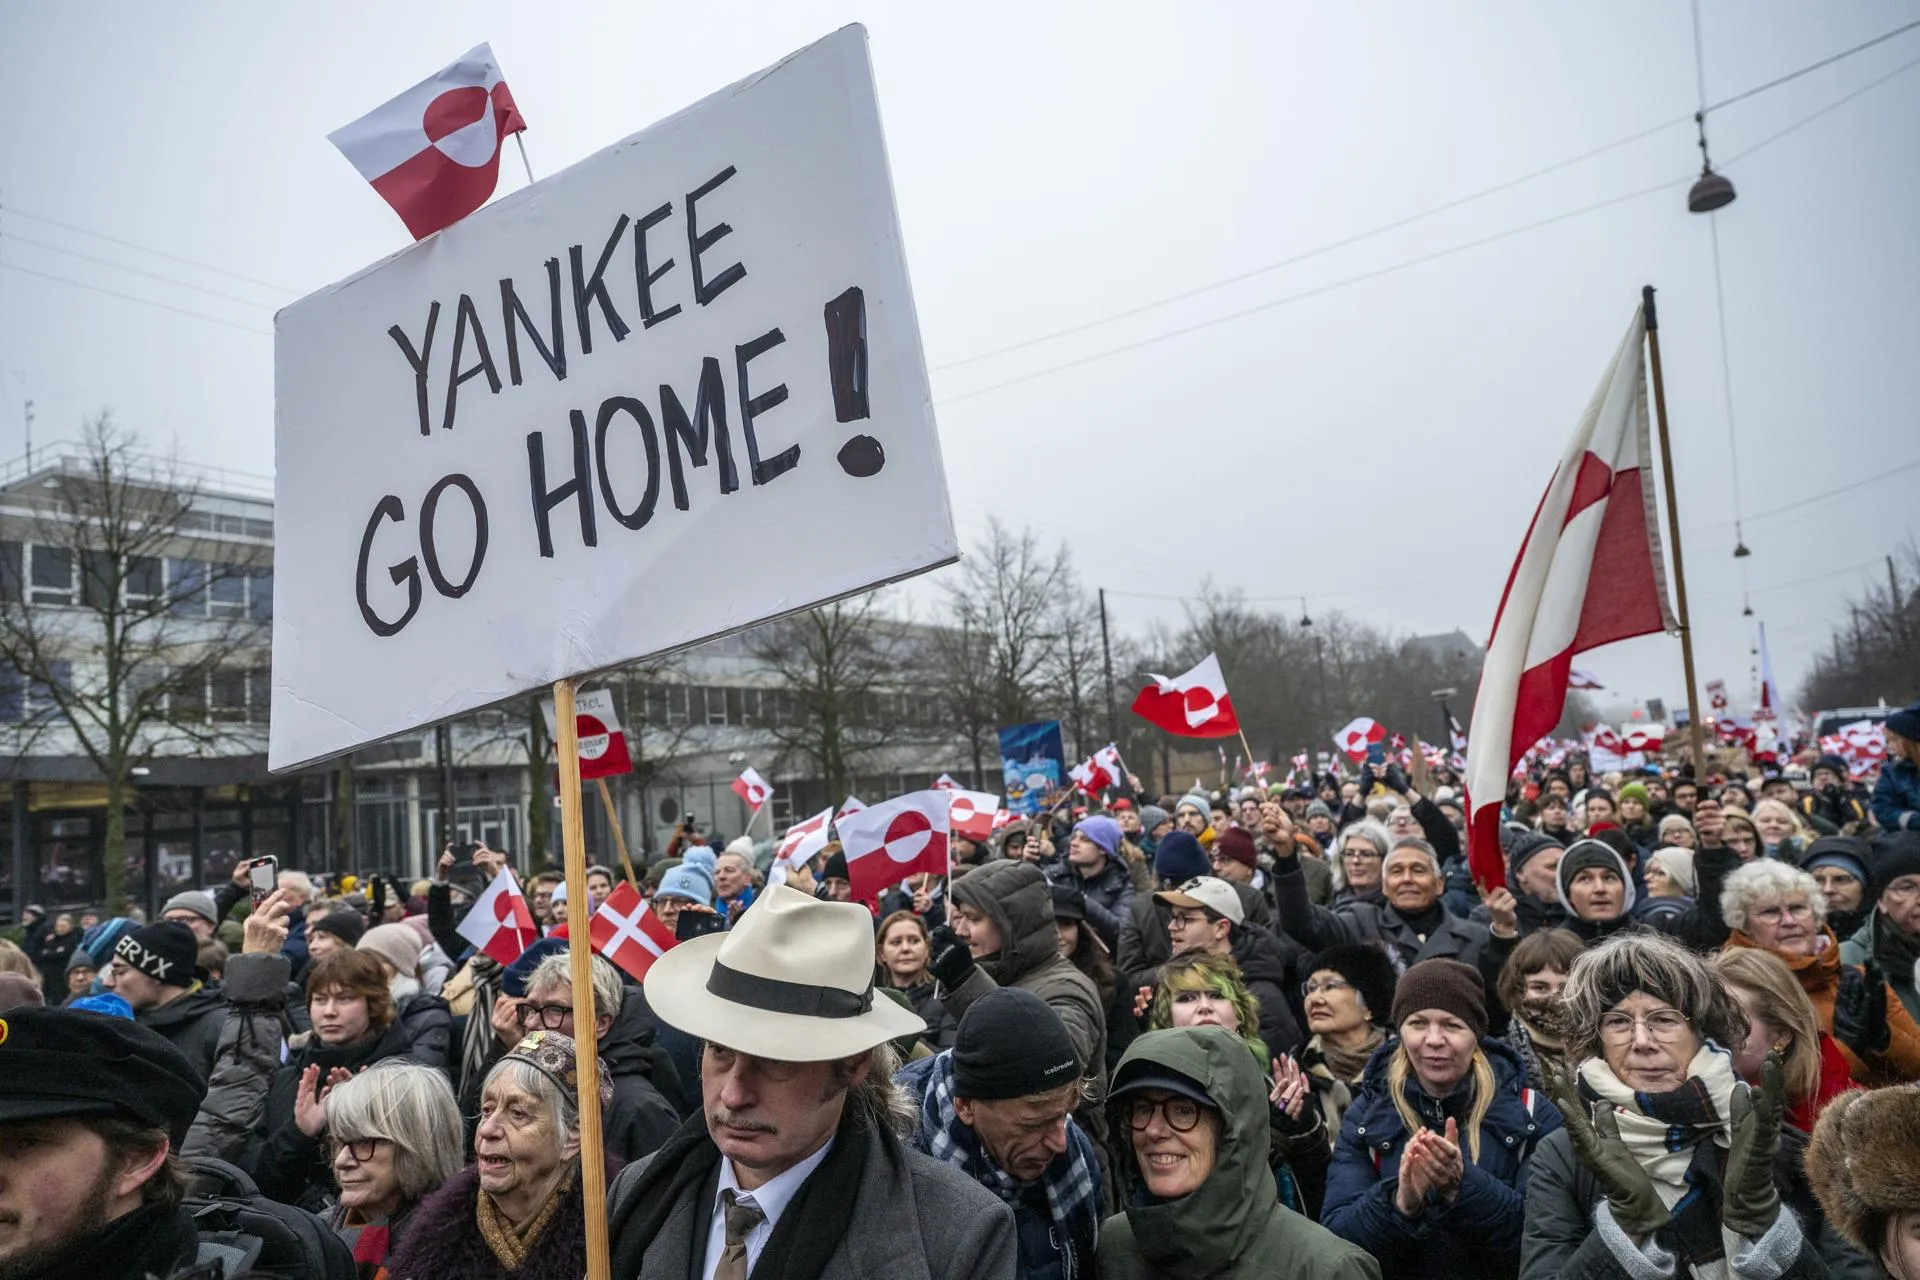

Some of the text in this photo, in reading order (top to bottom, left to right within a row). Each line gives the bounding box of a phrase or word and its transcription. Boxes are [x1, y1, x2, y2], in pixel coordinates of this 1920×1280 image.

[387, 165, 748, 437] YANKEE
[355, 473, 489, 637] GO
[115, 935, 174, 979] ERYX
